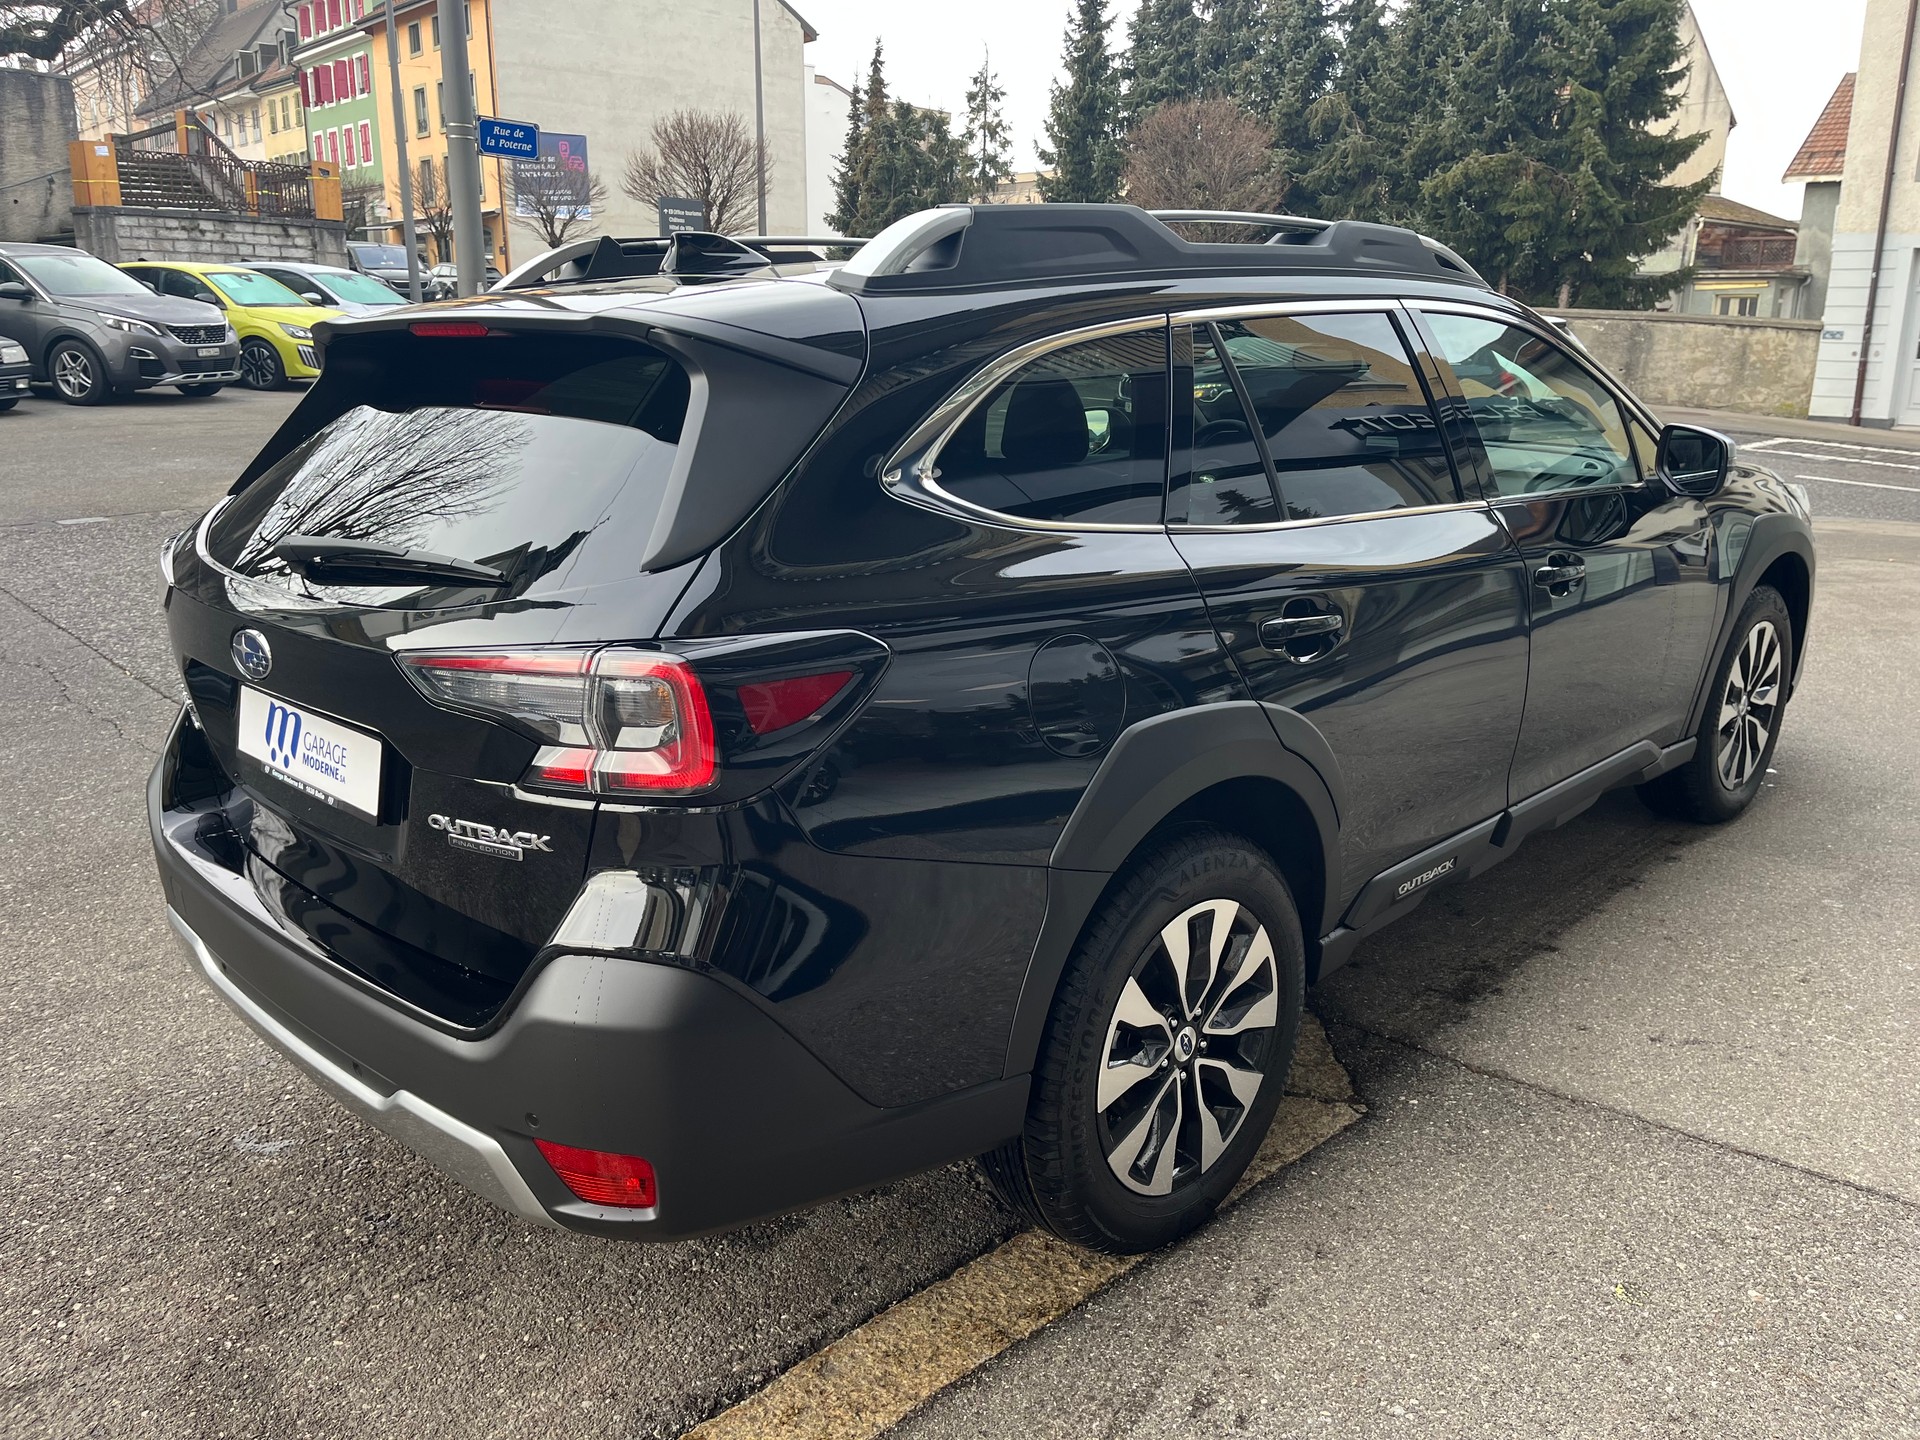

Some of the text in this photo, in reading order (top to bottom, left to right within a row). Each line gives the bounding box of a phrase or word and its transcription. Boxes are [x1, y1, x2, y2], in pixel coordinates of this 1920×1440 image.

[486, 136, 532, 151] la Poterne
[493, 126, 524, 139] Rue de
[303, 731, 347, 767] GARAGE
[302, 753, 346, 784] MODERNE SA
[427, 813, 554, 852] OUTBACK
[452, 838, 515, 857] FINAL EDITION
[1180, 853, 1249, 887] ALENZA
[1398, 858, 1454, 895] OUTBACK
